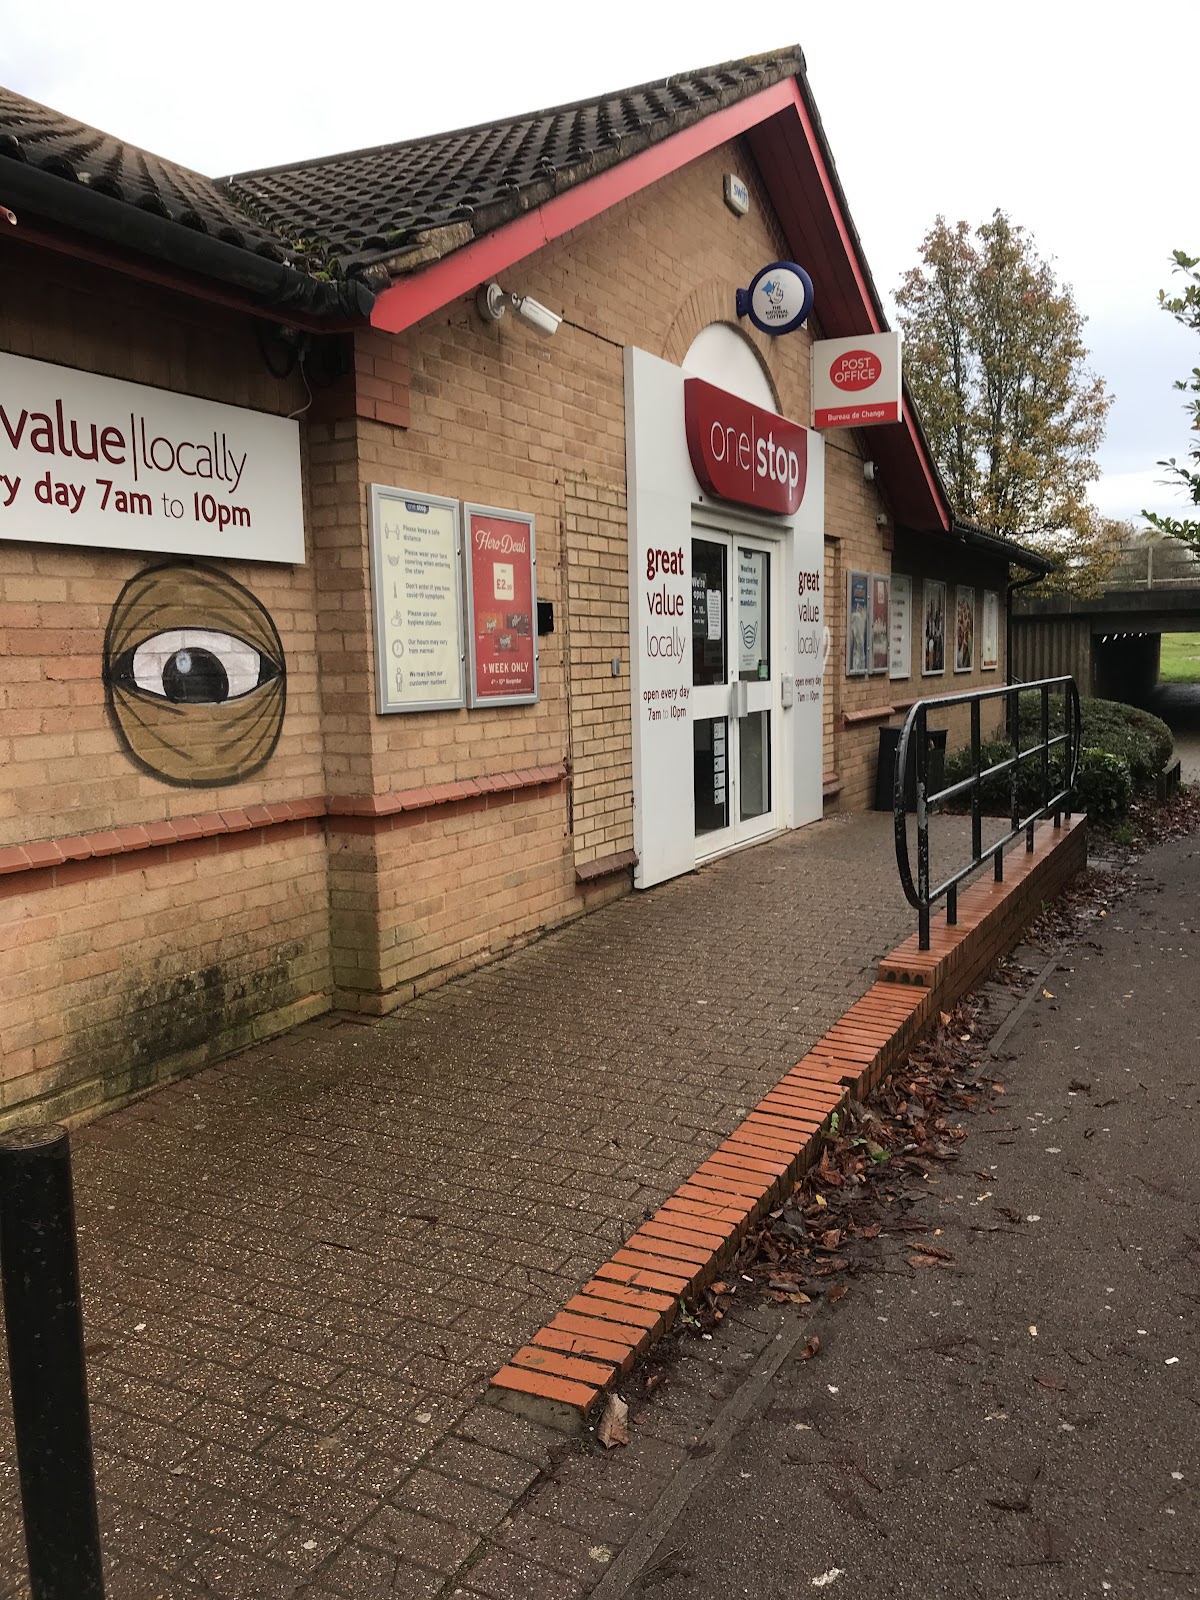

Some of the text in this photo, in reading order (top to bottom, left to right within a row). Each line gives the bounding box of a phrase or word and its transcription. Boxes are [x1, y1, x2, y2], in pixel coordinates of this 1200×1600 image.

[841, 357, 871, 371] POST
[834, 368, 875, 383] OFFICE
[827, 410, 885, 422] Bureau de Change
[0, 398, 247, 494] value locally
[711, 421, 799, 501] one stop
[34, 471, 86, 514] day
[96, 478, 152, 516] 7am
[161, 492, 184, 518] to
[194, 491, 251, 532] 10pm
[403, 524, 417, 533] Please
[403, 535, 421, 543] distance
[475, 530, 526, 554] Hero Deals
[404, 549, 418, 557] Please
[404, 559, 423, 567] covering
[646, 547, 685, 581] great
[798, 570, 820, 596] great
[646, 583, 684, 617] value
[407, 609, 422, 617] Please
[798, 597, 820, 622] value
[646, 625, 686, 664] locally
[797, 629, 820, 659] locally
[482, 661, 529, 674] 1 WEEK ONLY
[795, 678, 805, 687] open
[805, 677, 815, 687] every
[643, 685, 690, 703] open every day
[797, 692, 806, 702] 7am
[648, 705, 687, 722] 7am to 10pm
